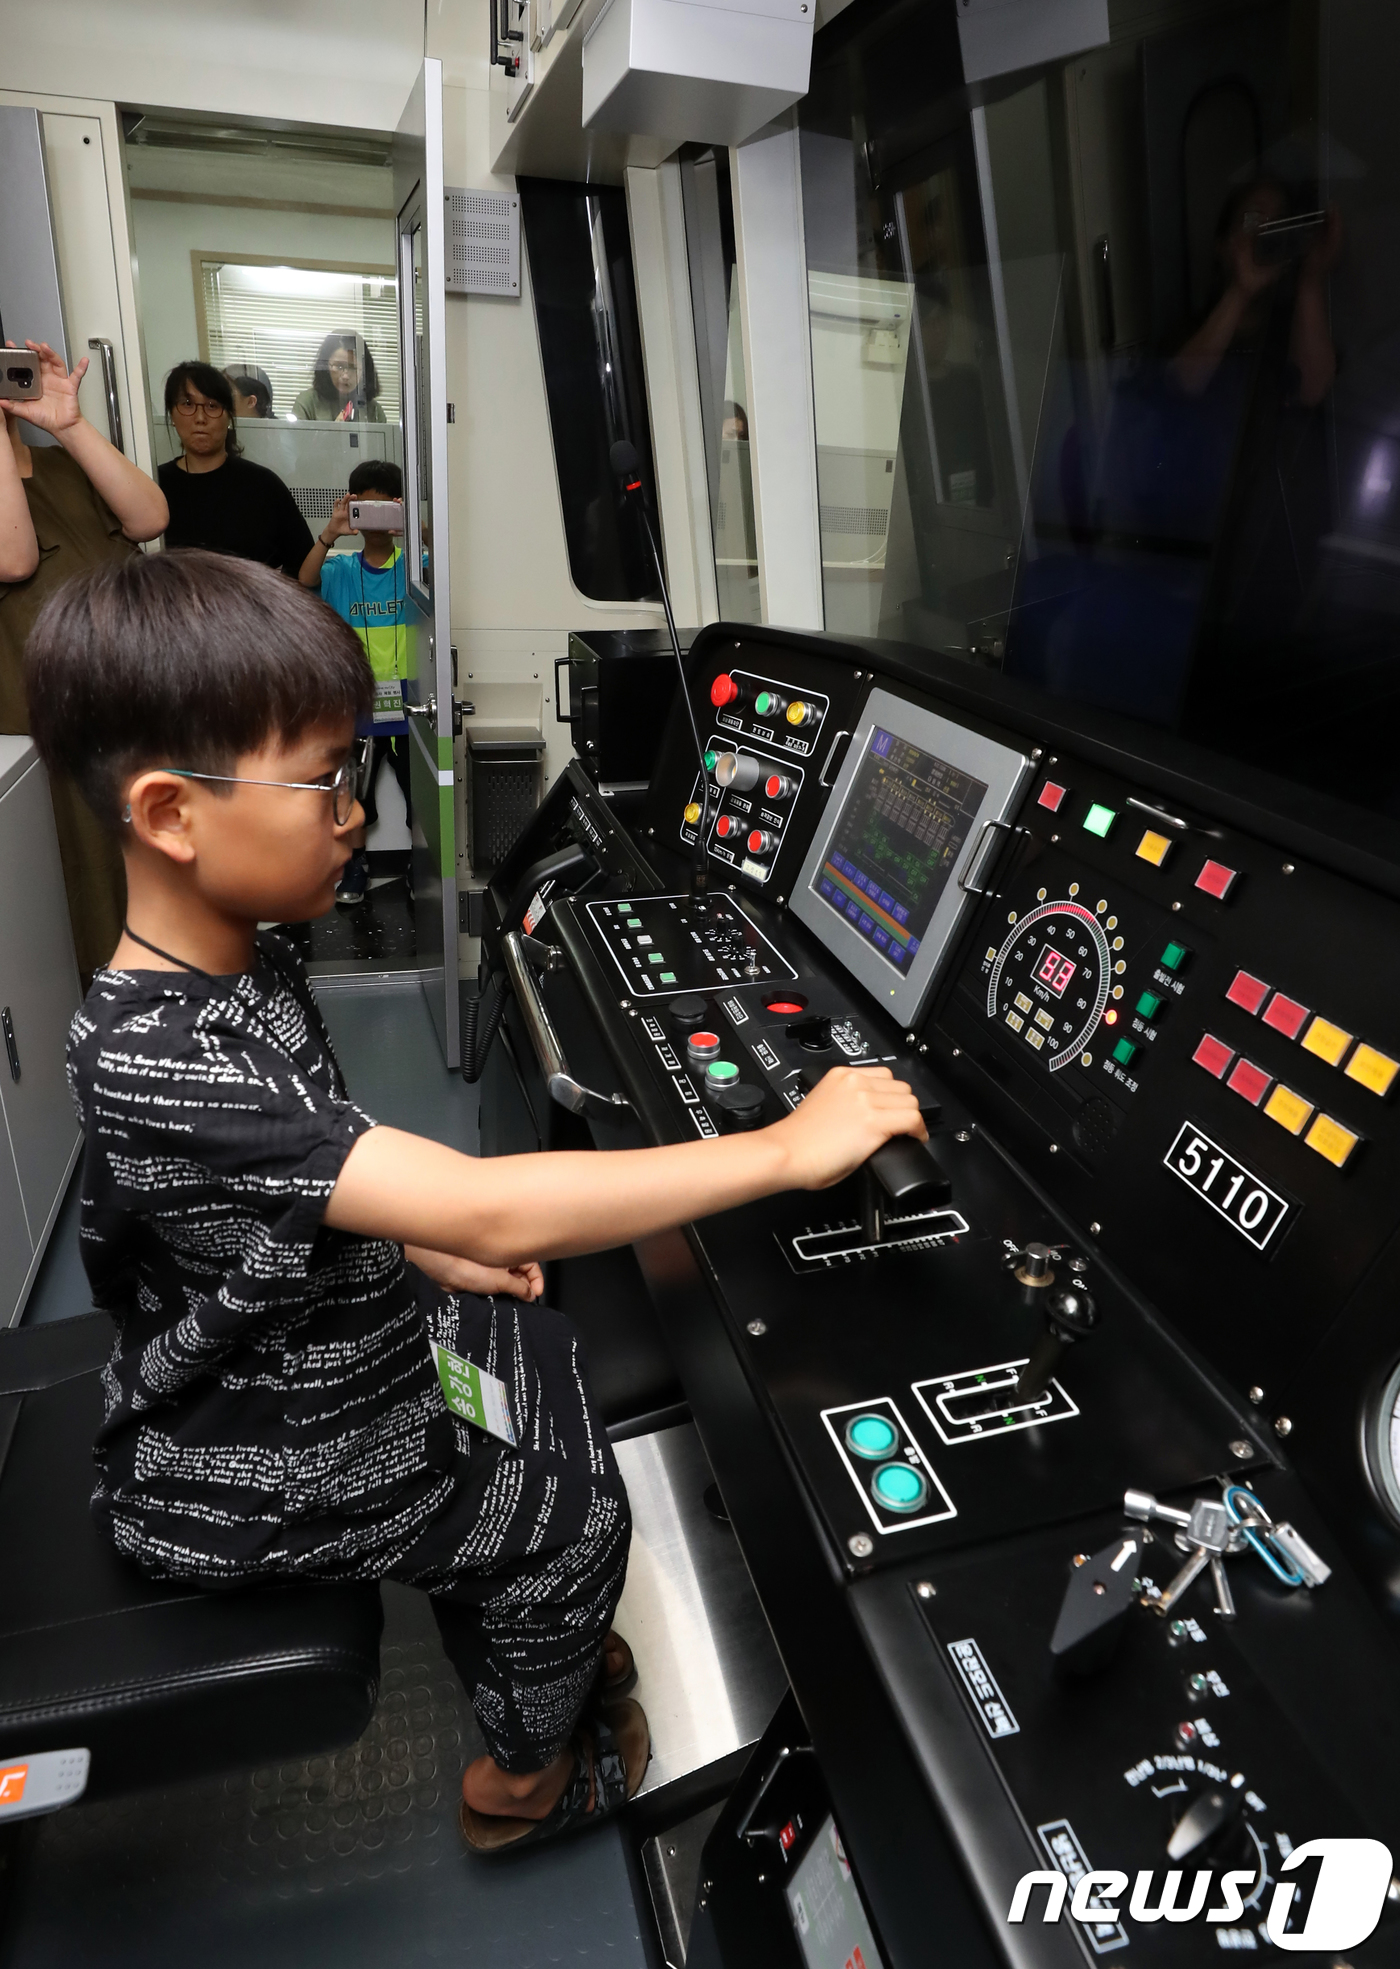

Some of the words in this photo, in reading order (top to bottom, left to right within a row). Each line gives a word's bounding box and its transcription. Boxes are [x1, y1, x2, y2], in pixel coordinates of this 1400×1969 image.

[350, 600, 405, 616] ATHLET
[876, 735, 889, 754] M
[1046, 925, 1057, 936] 40
[1065, 928, 1076, 940] 50
[1027, 936, 1037, 947] 30
[1014, 951, 1025, 962] 20
[1078, 946, 1088, 957] 60
[1082, 967, 1093, 979] 70
[1005, 976, 1013, 987] 10
[1171, 979, 1186, 996] 시험
[1033, 985, 1051, 1003] Km/h
[1003, 1003, 1009, 1012] 0
[1076, 998, 1087, 1010] 80
[1062, 1021, 1073, 1034] 90
[1143, 1026, 1158, 1042] 시험
[1047, 1036, 1060, 1050] 100
[172, 1072, 215, 1084] growing
[153, 1095, 180, 1107] there
[183, 1100, 204, 1108] was
[1177, 1137, 1270, 1233] 5110
[1002, 1239, 1020, 1254] OFF
[975, 1374, 985, 1383] N
[1006, 1368, 1018, 1377] F
[303, 1378, 325, 1389] wall,
[943, 1381, 955, 1390] R
[1035, 1409, 1048, 1417] F
[1004, 1416, 1015, 1425] N
[970, 1424, 982, 1433] R
